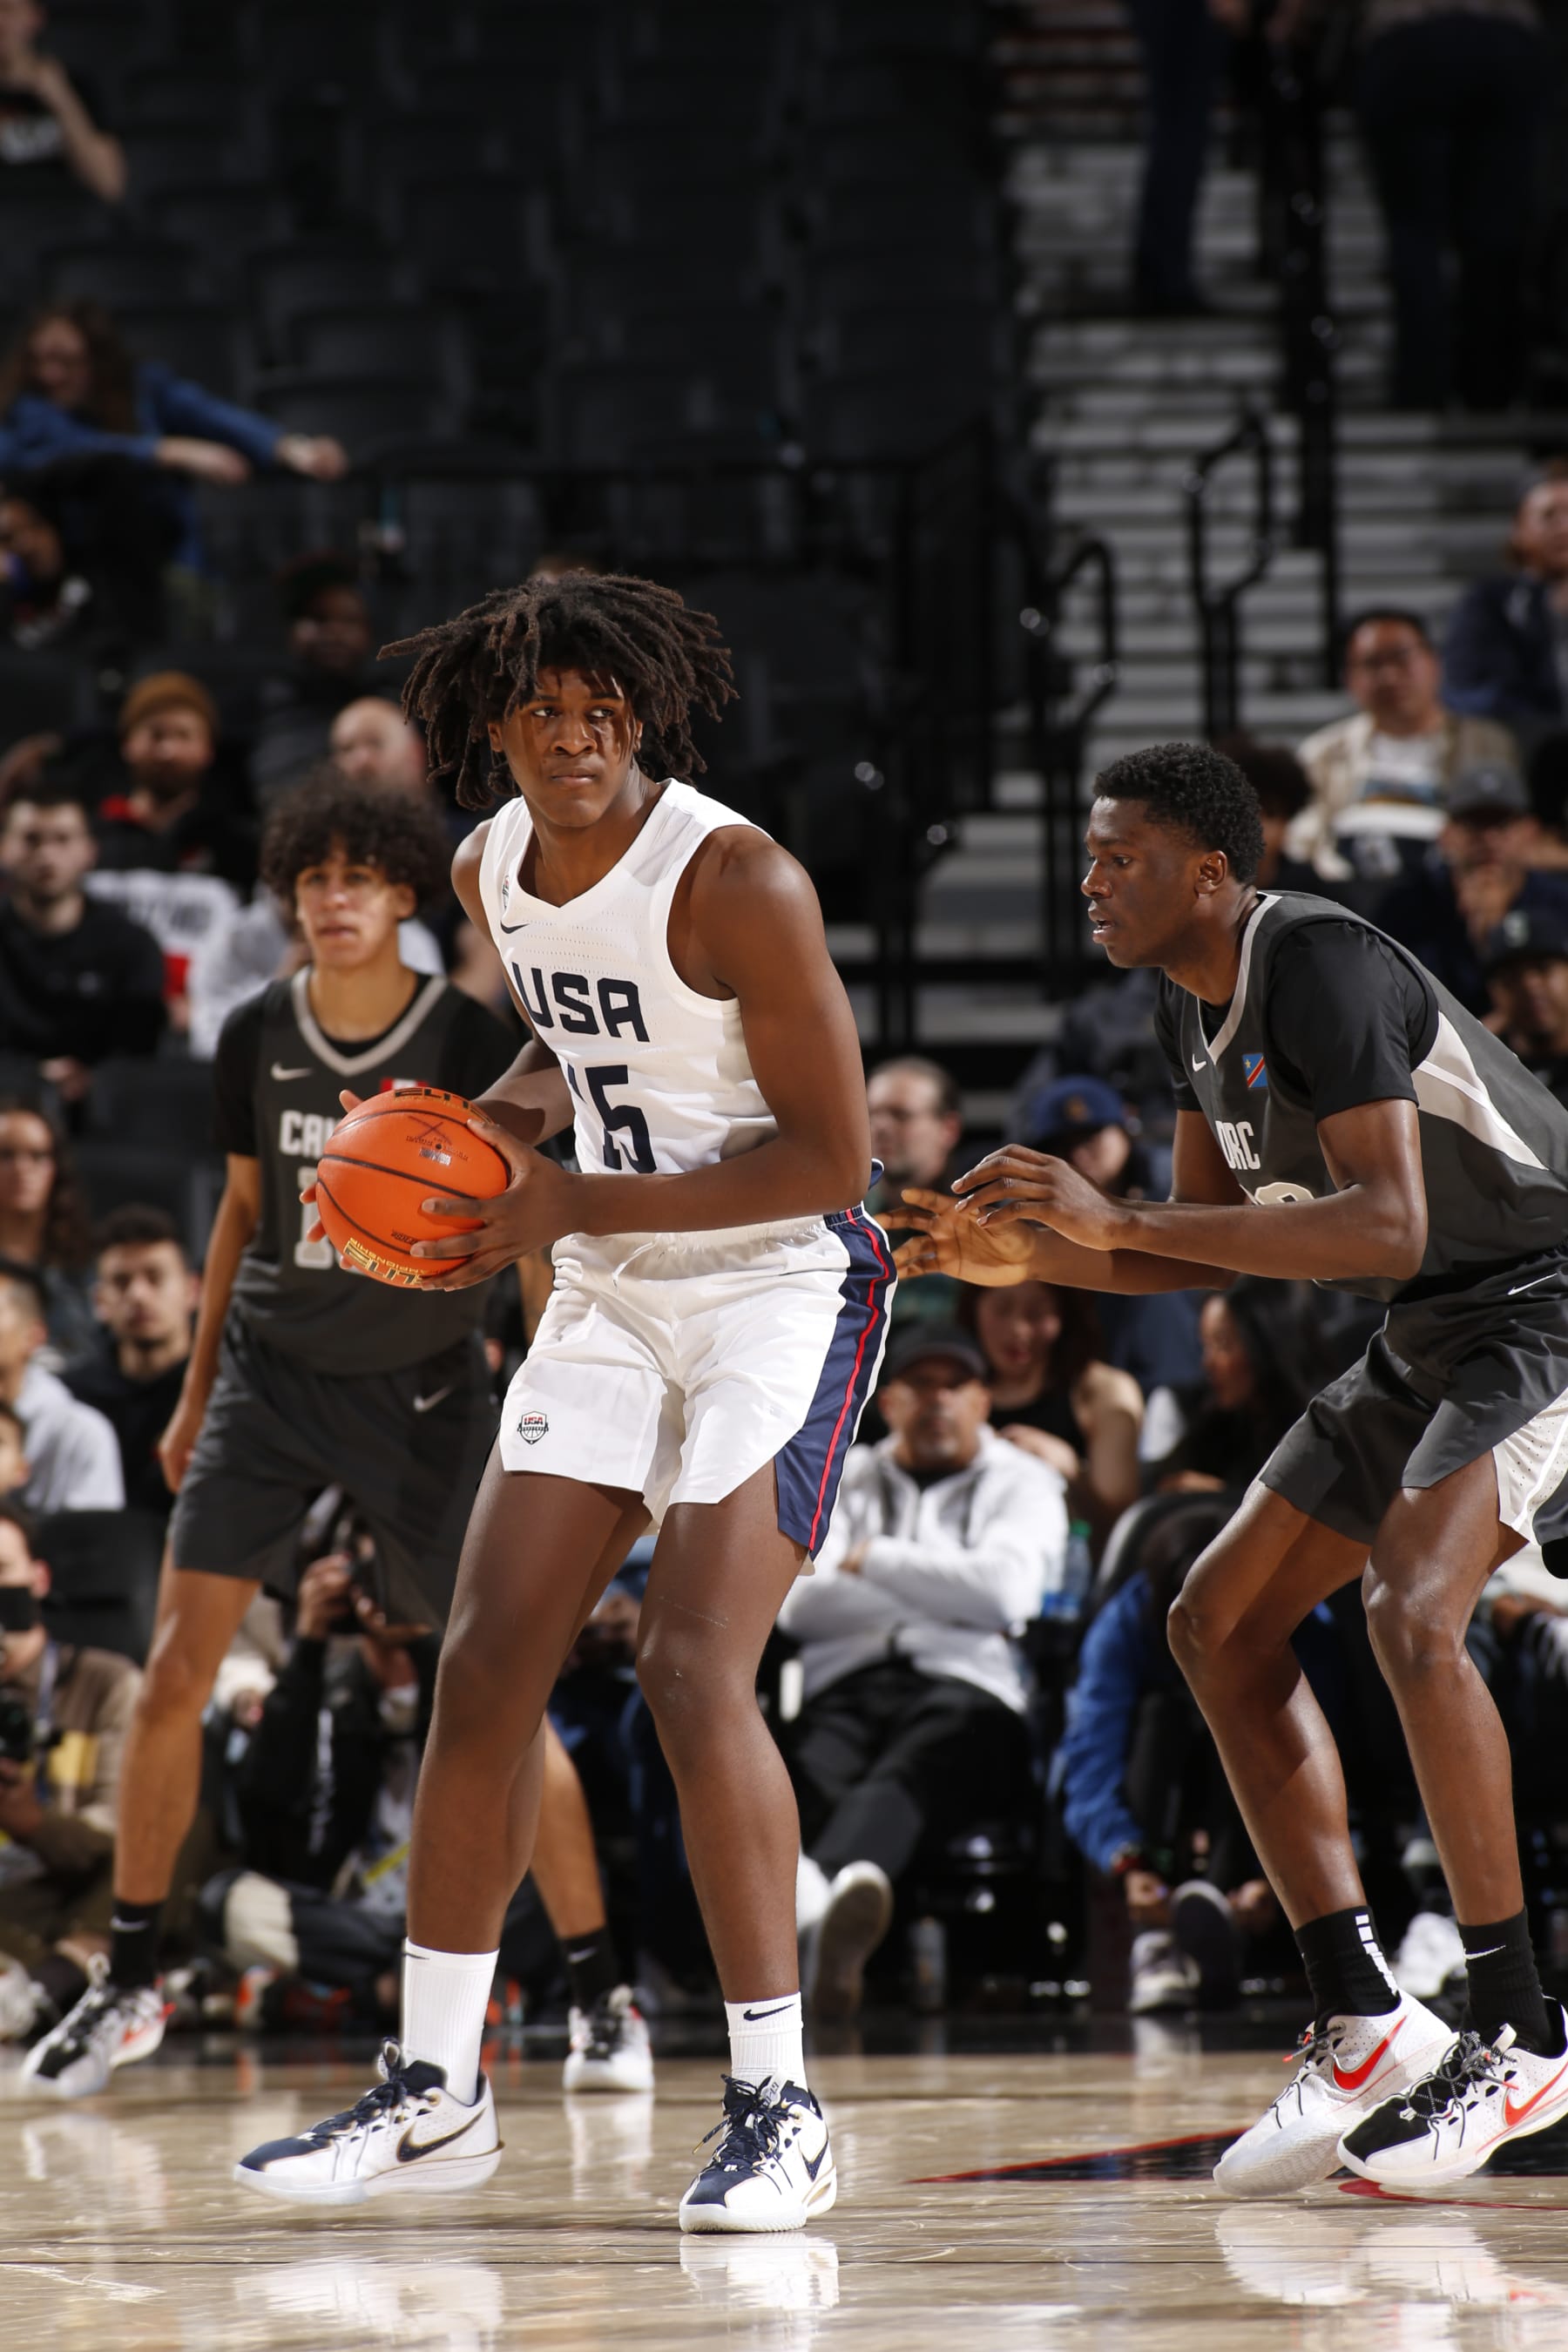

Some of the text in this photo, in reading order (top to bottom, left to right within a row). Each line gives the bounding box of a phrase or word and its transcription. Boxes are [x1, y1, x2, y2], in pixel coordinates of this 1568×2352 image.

[511, 961, 651, 1043] USA
[1215, 1120, 1261, 1170] DRC
[524, 1416, 543, 1425] USA
